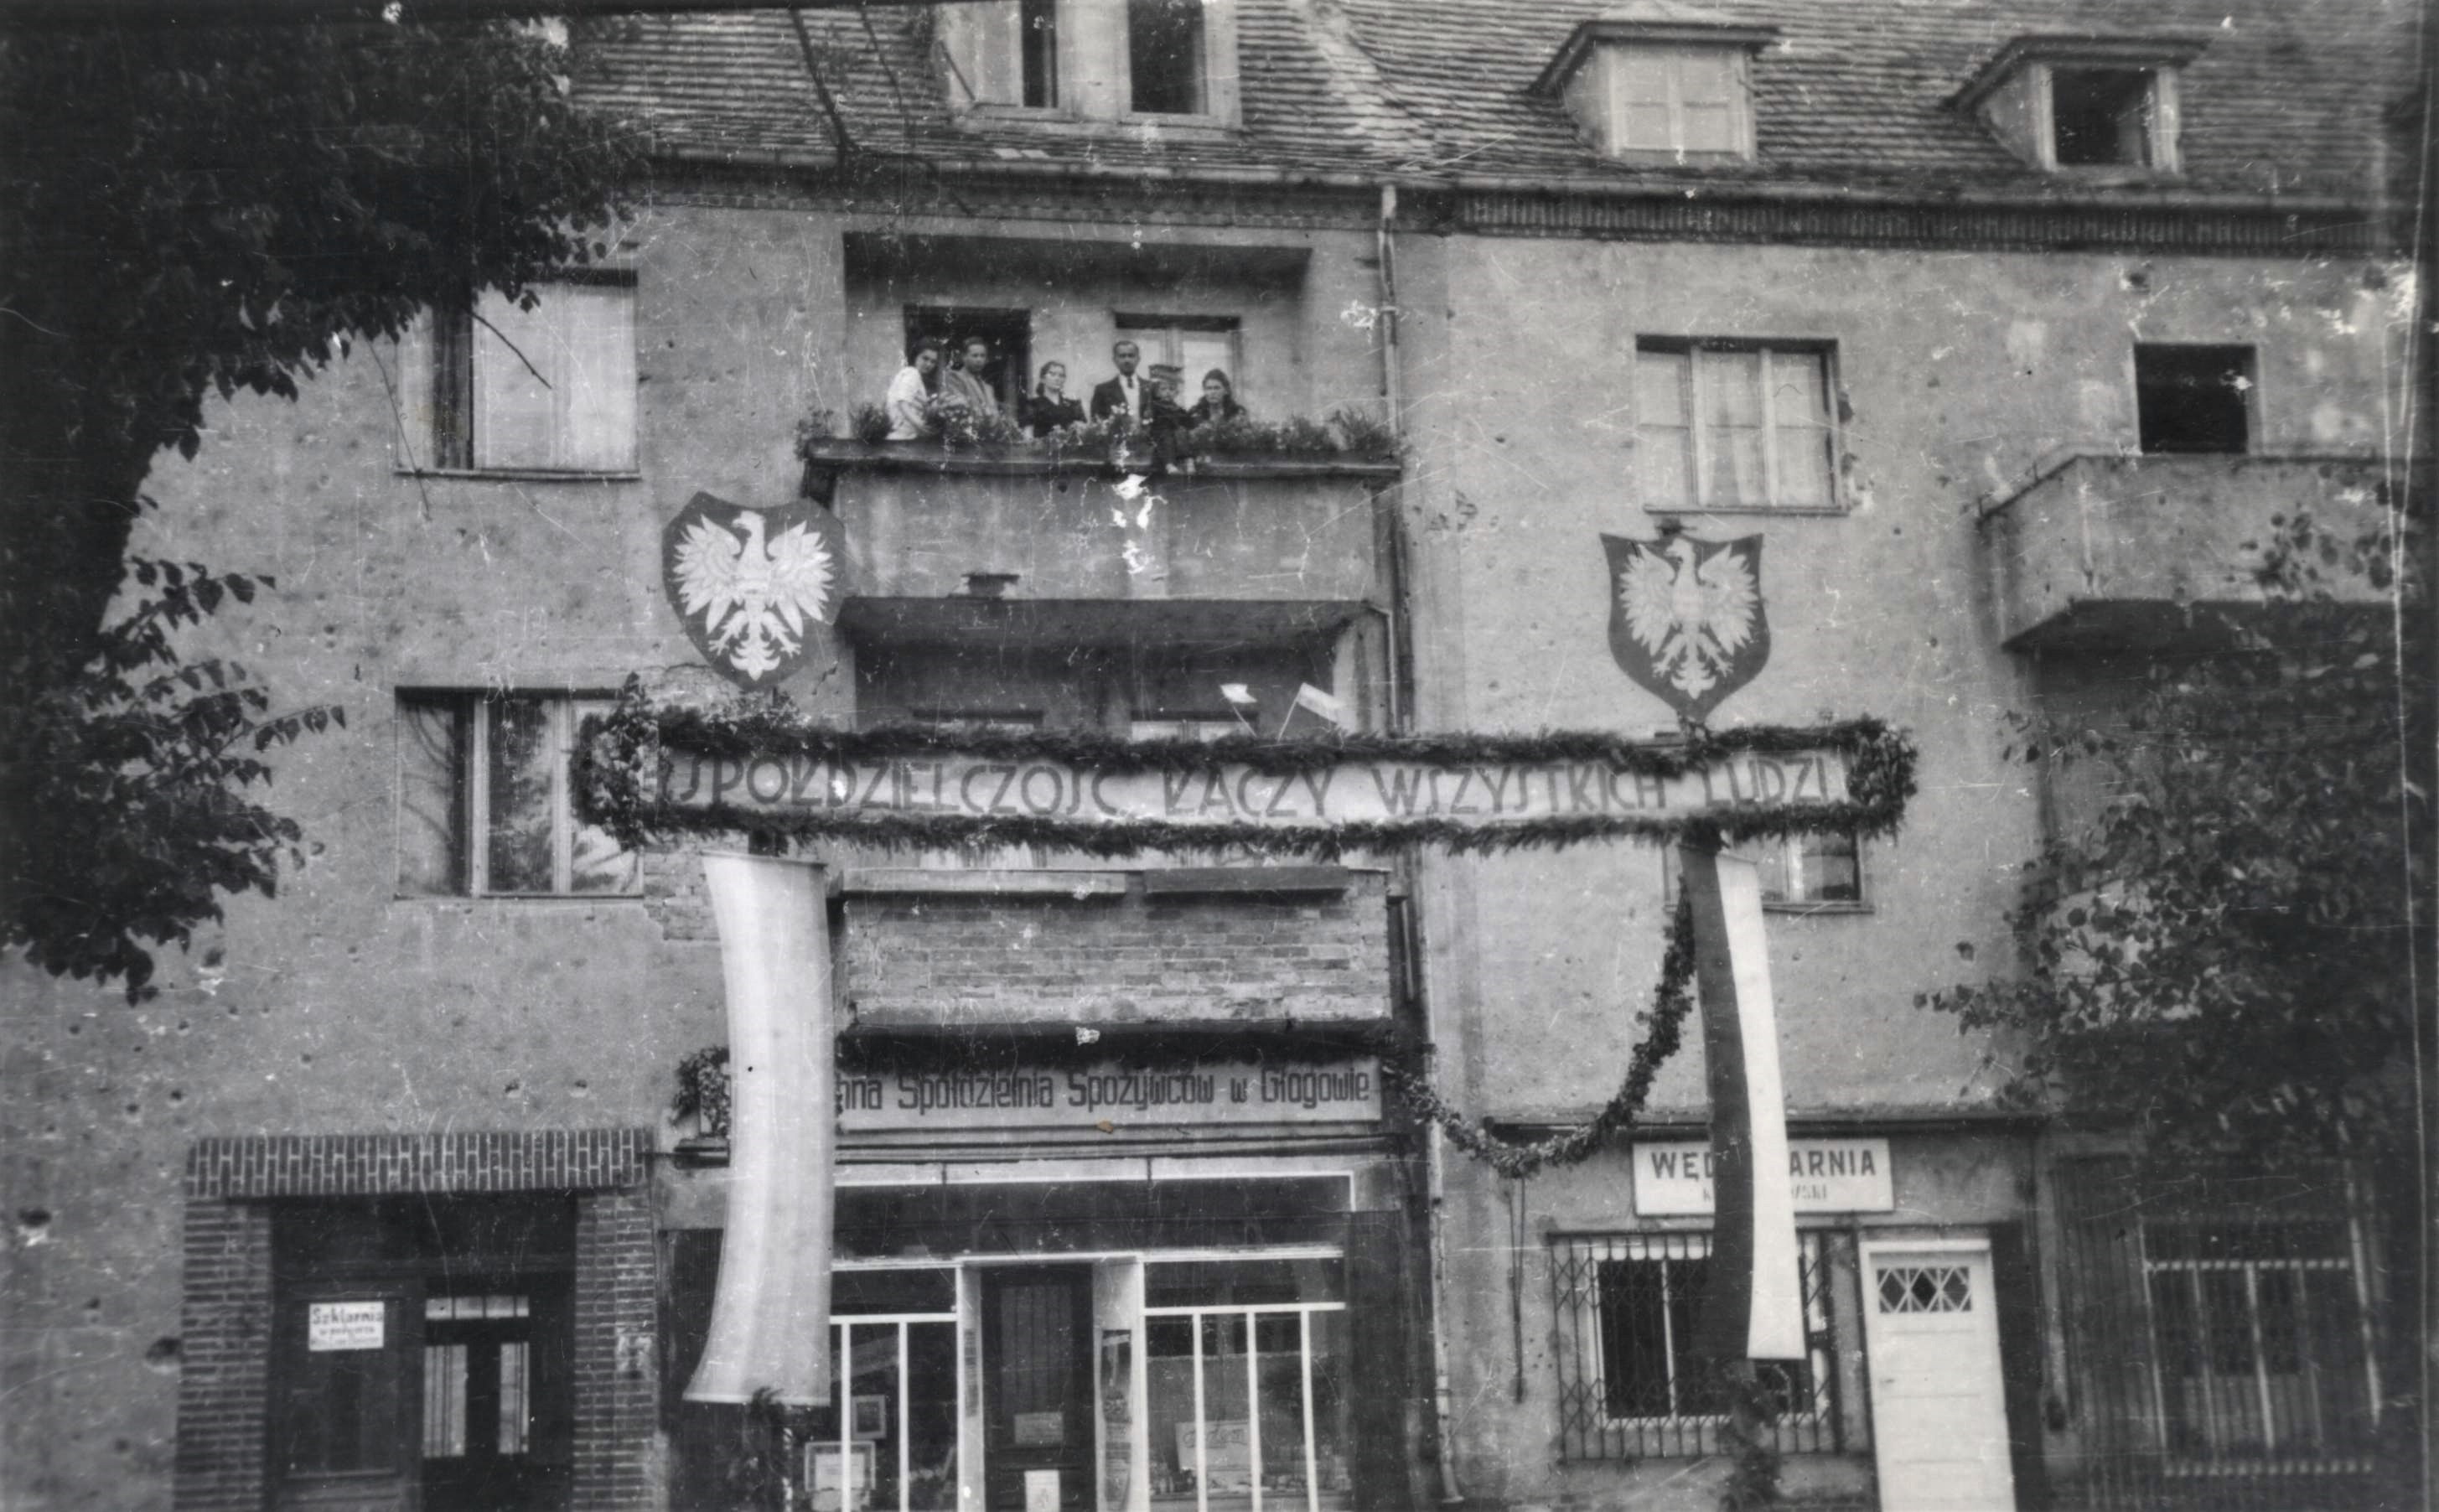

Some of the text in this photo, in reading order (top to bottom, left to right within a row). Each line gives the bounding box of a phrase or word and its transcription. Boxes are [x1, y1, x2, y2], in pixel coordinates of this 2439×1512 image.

[1371, 764, 1667, 816] WSZYSTKICH
[1701, 756, 1828, 806] LUDZI
[1230, 1078, 1248, 1103] w
[1261, 1066, 1370, 1110] Głogowie
